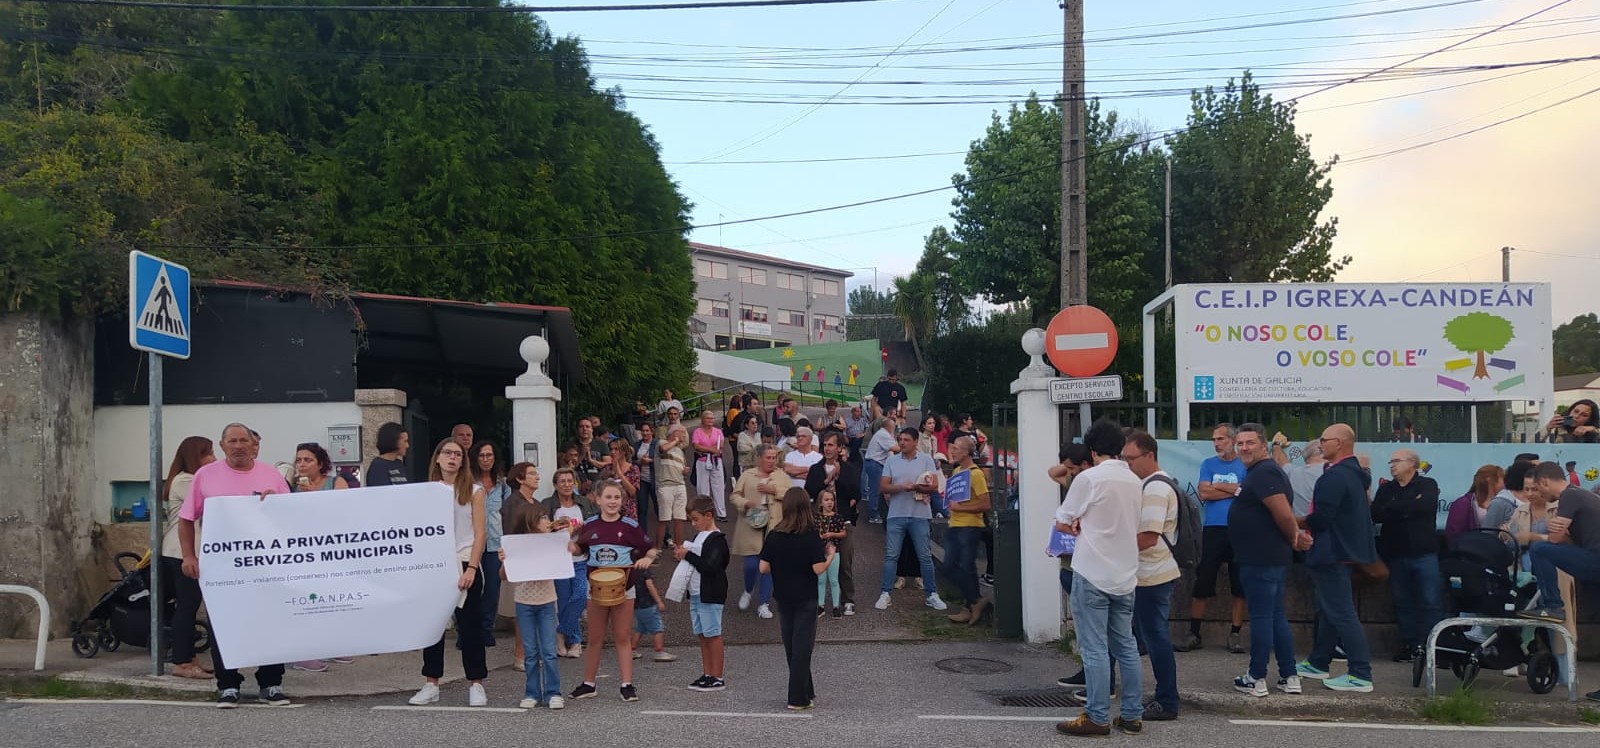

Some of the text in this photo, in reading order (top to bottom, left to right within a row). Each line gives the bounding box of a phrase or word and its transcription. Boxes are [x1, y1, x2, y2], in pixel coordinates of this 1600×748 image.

[1195, 285, 1533, 309] C.E.I.P IGREXA-CANDEÁN
[1228, 325, 1287, 341] NOSO
[1293, 324, 1354, 343] COLE,
[1276, 350, 1292, 367] O
[1298, 350, 1356, 367] VOSO
[1054, 379, 1116, 391] EXCEPTO SERVIZOS
[1219, 377, 1249, 385] XUNTA
[1265, 376, 1302, 384] GALICIA
[1057, 390, 1114, 401] CENTRO ESCOLAR
[202, 525, 446, 554] CONTRA A PRIVATIZACIÓN DOS
[234, 543, 414, 568] SERVIZOS MUNICIPAIS
[345, 568, 372, 577] centros
[384, 564, 407, 573] ensino
[408, 561, 434, 571] público
